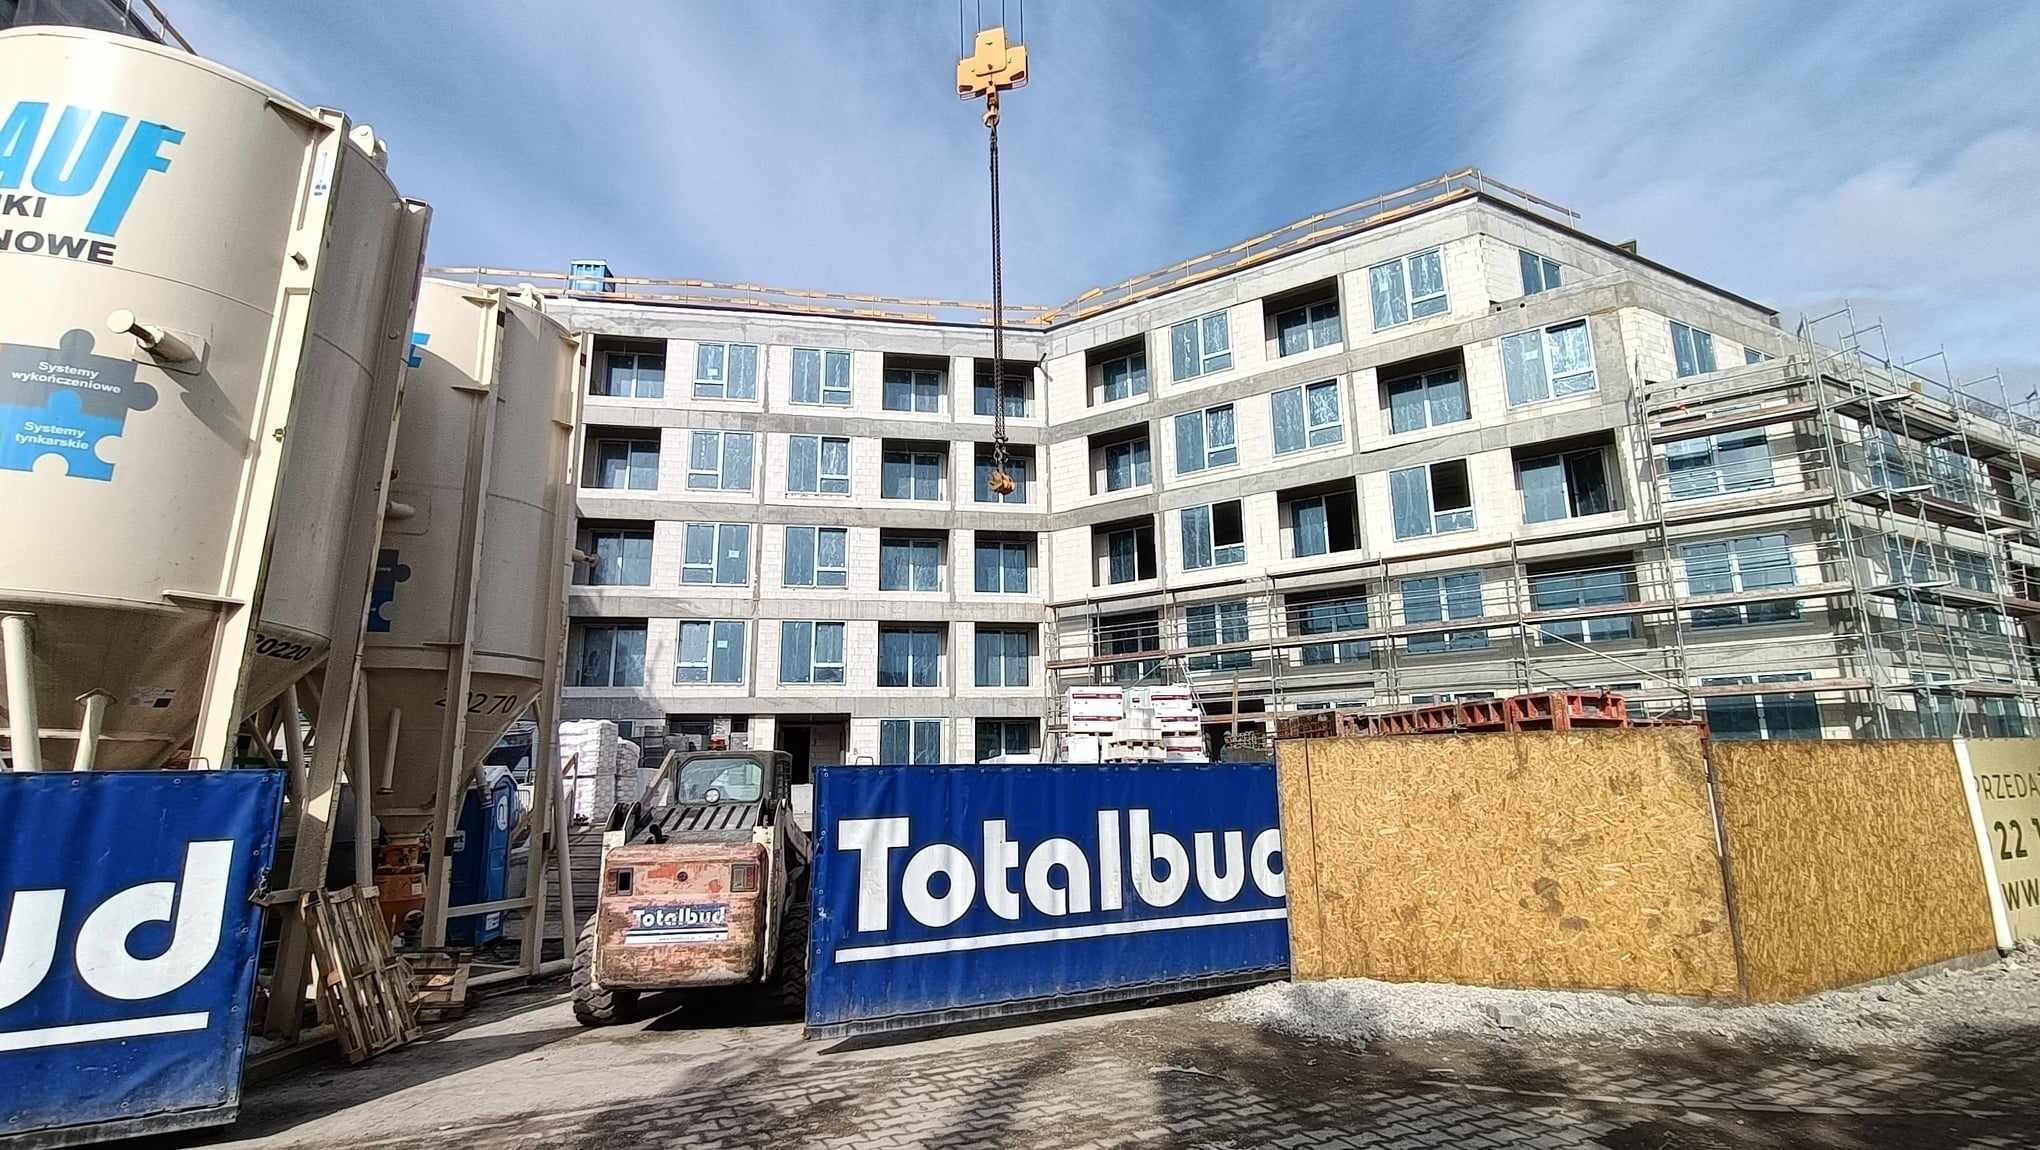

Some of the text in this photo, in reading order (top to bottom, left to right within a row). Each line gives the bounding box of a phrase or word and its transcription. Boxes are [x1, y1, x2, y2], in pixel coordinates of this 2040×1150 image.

[0, 101, 186, 237] AUF
[0, 194, 47, 218] KI
[39, 361, 99, 379] Systemy
[11, 371, 121, 394] wykończeniowe
[24, 421, 85, 438] Systemy
[15, 433, 89, 450] tynkarskie
[434, 687, 517, 714] 270
[1974, 766, 2040, 800] RZEDA
[1994, 819, 2028, 860] 22
[633, 906, 725, 927] Totalbud
